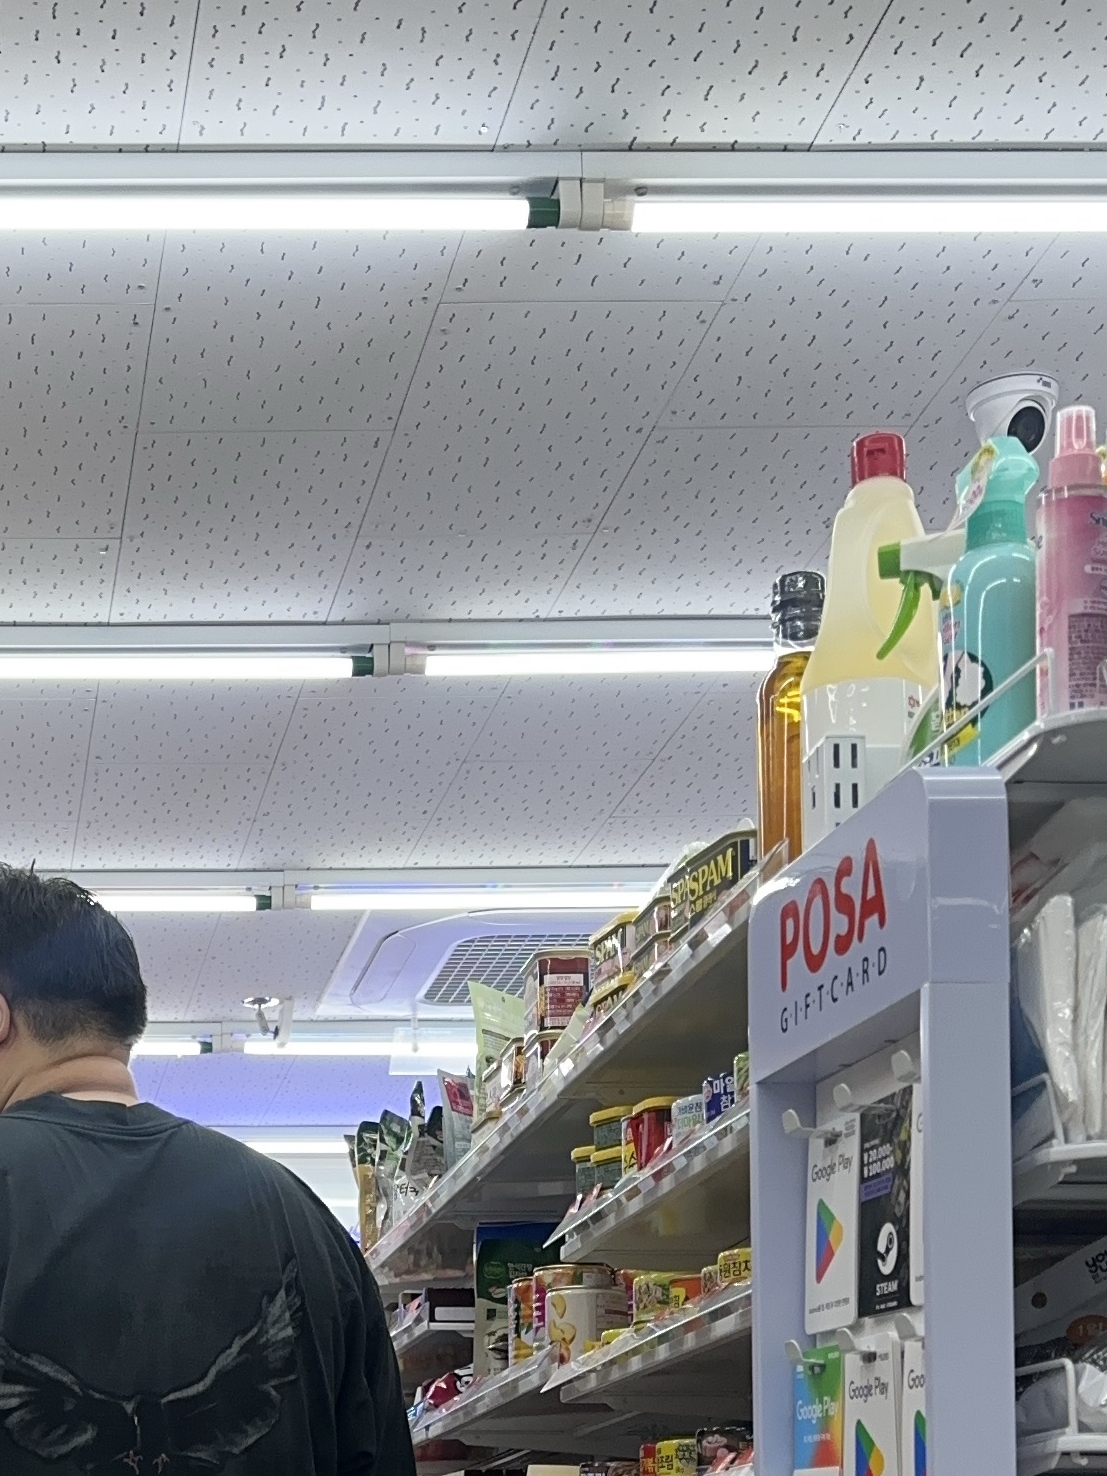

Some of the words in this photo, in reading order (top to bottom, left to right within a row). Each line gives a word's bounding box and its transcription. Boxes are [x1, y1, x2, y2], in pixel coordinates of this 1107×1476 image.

[689, 846, 735, 902] SPAM
[779, 838, 887, 993] POSA
[811, 1157, 837, 1182] Google
[838, 1153, 854, 1174] Play
[876, 1279, 898, 1296] STEAM
[849, 1379, 873, 1403] Google
[874, 1376, 889, 1399] Play
[796, 1401, 821, 1424] Google
